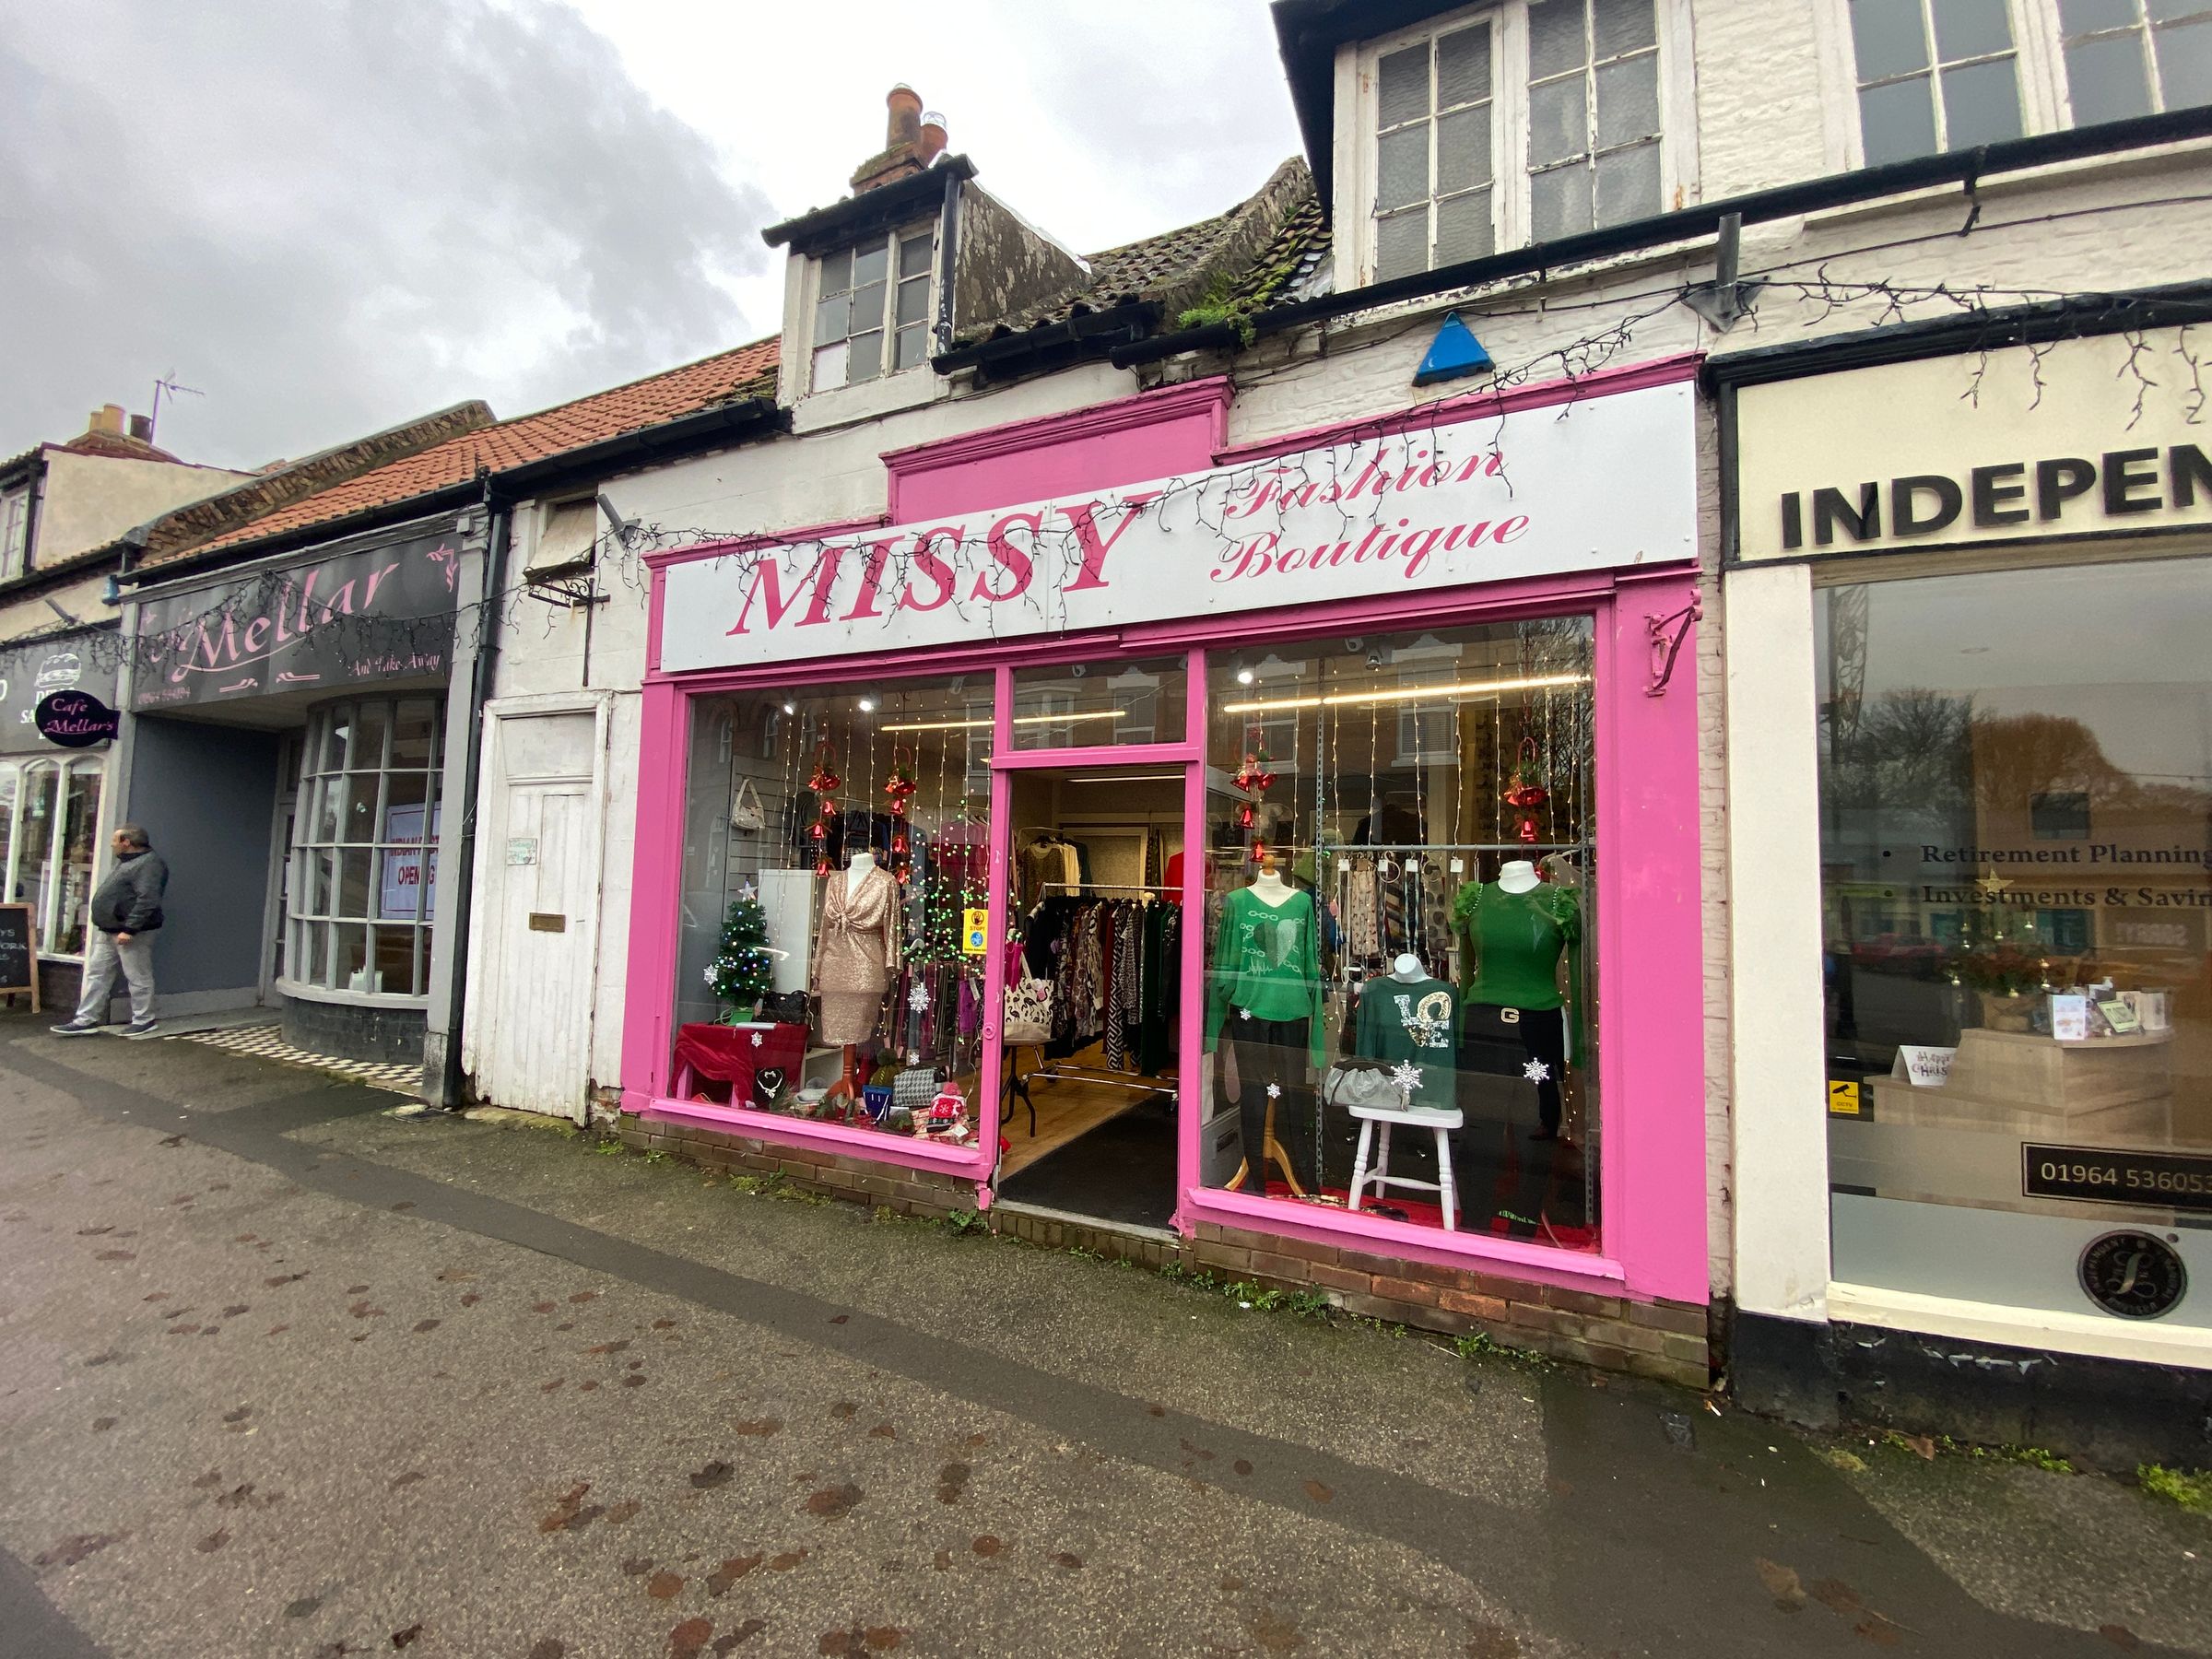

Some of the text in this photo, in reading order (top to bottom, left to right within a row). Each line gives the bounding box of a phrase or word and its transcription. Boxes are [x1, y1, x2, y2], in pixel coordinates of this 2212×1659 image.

[1226, 447, 1510, 520] Fashion
[1781, 444, 2212, 549] INDEPEN
[1209, 512, 1530, 581] Boutique
[726, 489, 1163, 637] MISSY
[171, 563, 400, 683] Mellar
[52, 698, 88, 716] Cafe
[44, 719, 113, 735] Mellar's
[1921, 843, 2212, 870] Retirement Planning
[398, 865, 436, 886] OPENG
[1922, 885, 2096, 907] Investments
[2104, 888, 2126, 906] &
[1500, 1007, 1520, 1024] G
[2041, 1161, 2118, 1185] 01964
